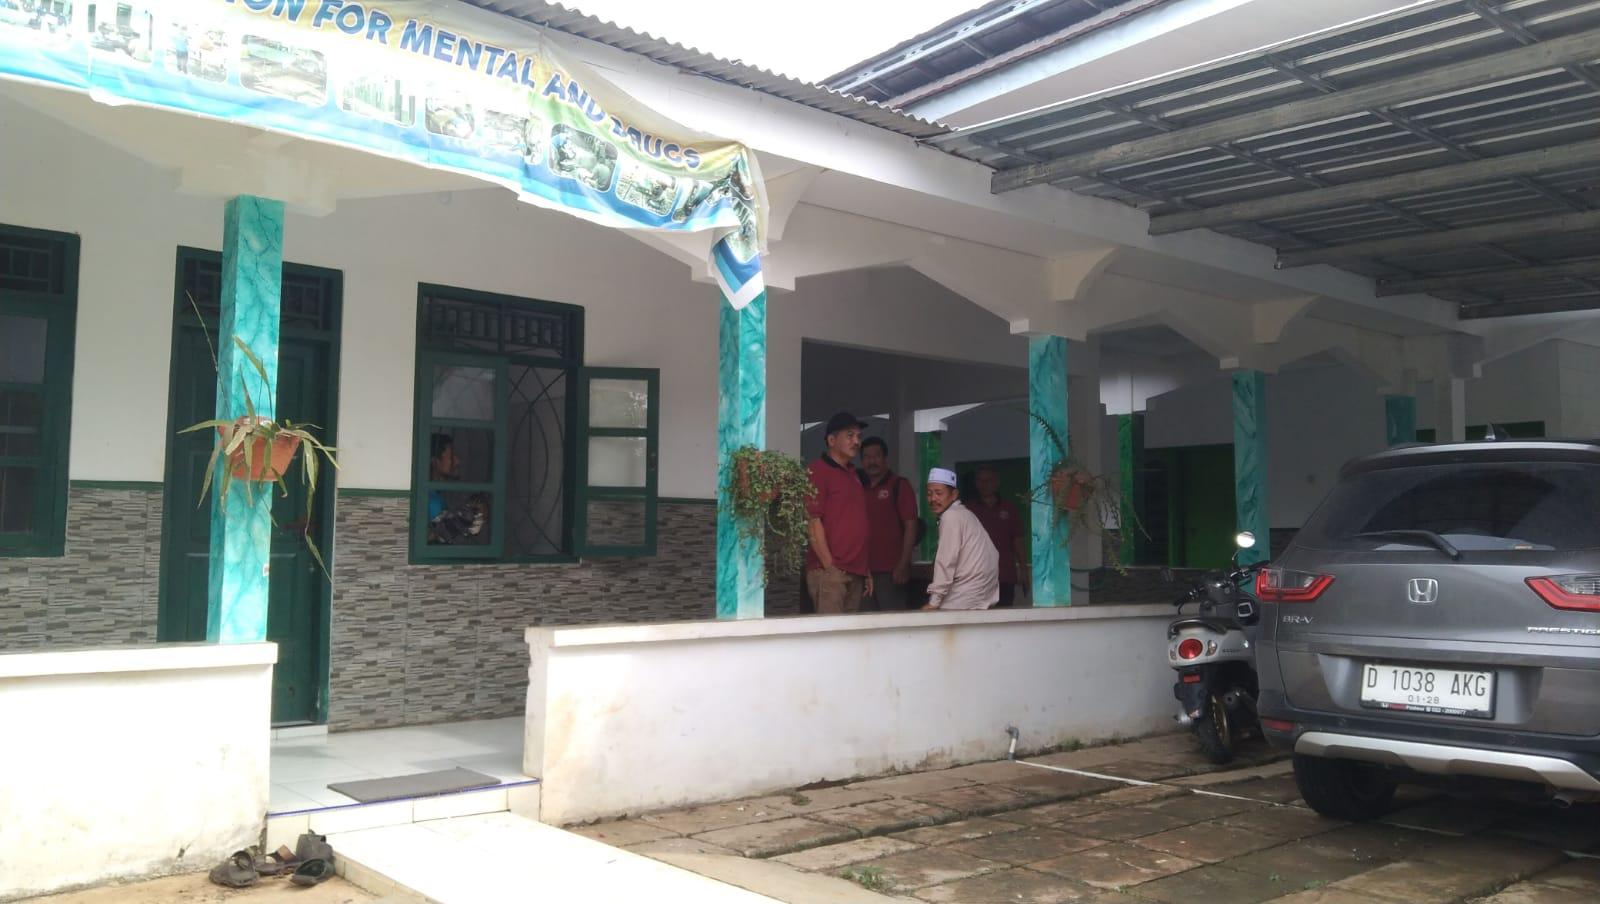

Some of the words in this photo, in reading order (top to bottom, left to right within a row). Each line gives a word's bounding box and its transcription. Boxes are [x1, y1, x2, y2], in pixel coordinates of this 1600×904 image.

[313, 0, 392, 44] FOR
[399, 19, 535, 88] MENTAL
[1282, 615, 1314, 624] BR-V
[1367, 667, 1378, 688] D
[1392, 669, 1435, 693] 1038
[1451, 673, 1487, 697] AKG
